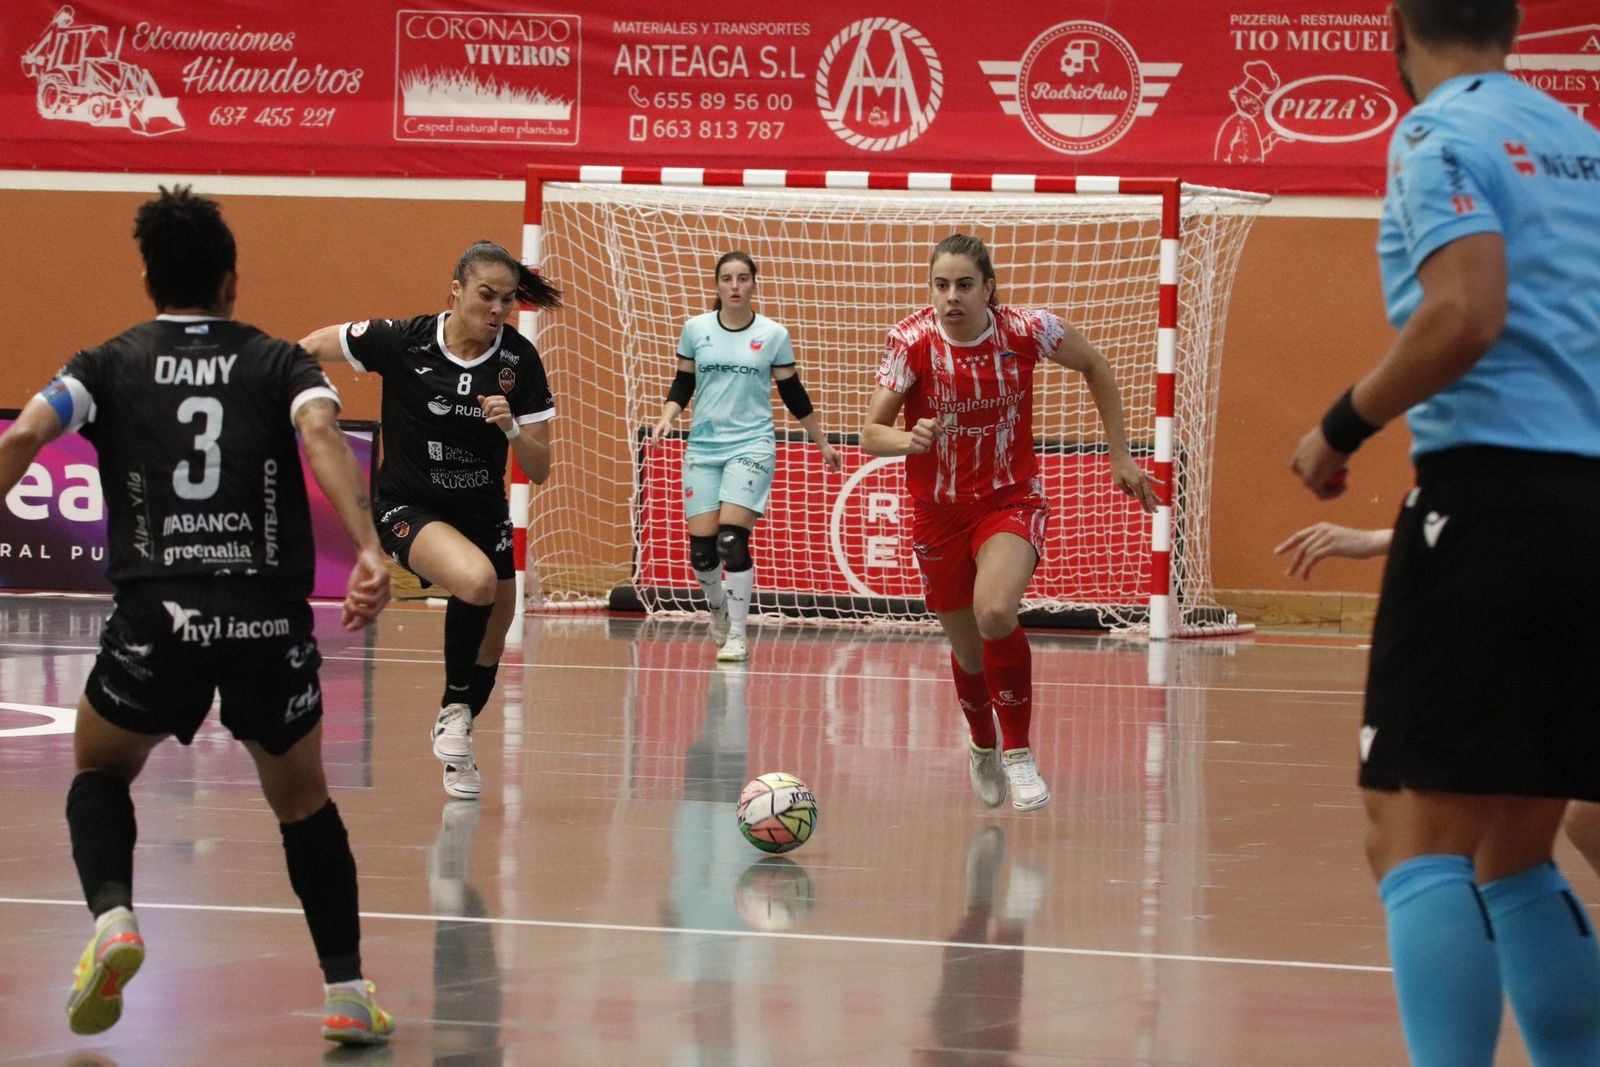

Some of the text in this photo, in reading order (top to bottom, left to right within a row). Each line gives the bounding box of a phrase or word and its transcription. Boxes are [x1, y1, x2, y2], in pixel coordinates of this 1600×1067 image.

[406, 16, 571, 42] CORONADO
[613, 22, 811, 36] MATERIALES Y TRANSPORTES
[1230, 14, 1290, 26] PIZZERIA
[132, 22, 296, 51] Excavaciones
[1231, 30, 1394, 51] TIO MIGUEL
[464, 44, 571, 67] VIVEROS
[613, 44, 806, 79] ARTEAGA S.L
[182, 57, 364, 94] Hilanderos
[654, 92, 793, 111] 655 89 56 00
[1031, 82, 1128, 100] RodriAuto
[209, 107, 336, 127] 637 455 221
[1278, 94, 1377, 120] PIZZA'S
[403, 117, 570, 139] Cesped natural en planchas
[653, 120, 785, 140] 663 813 787
[155, 354, 238, 386] DANY
[456, 373, 473, 395] 8
[927, 390, 1026, 414] Navalcarnero
[944, 413, 1021, 437] etecom
[172, 396, 224, 500] 3
[165, 512, 253, 535] ABANCA
[163, 541, 253, 566] greenalia
